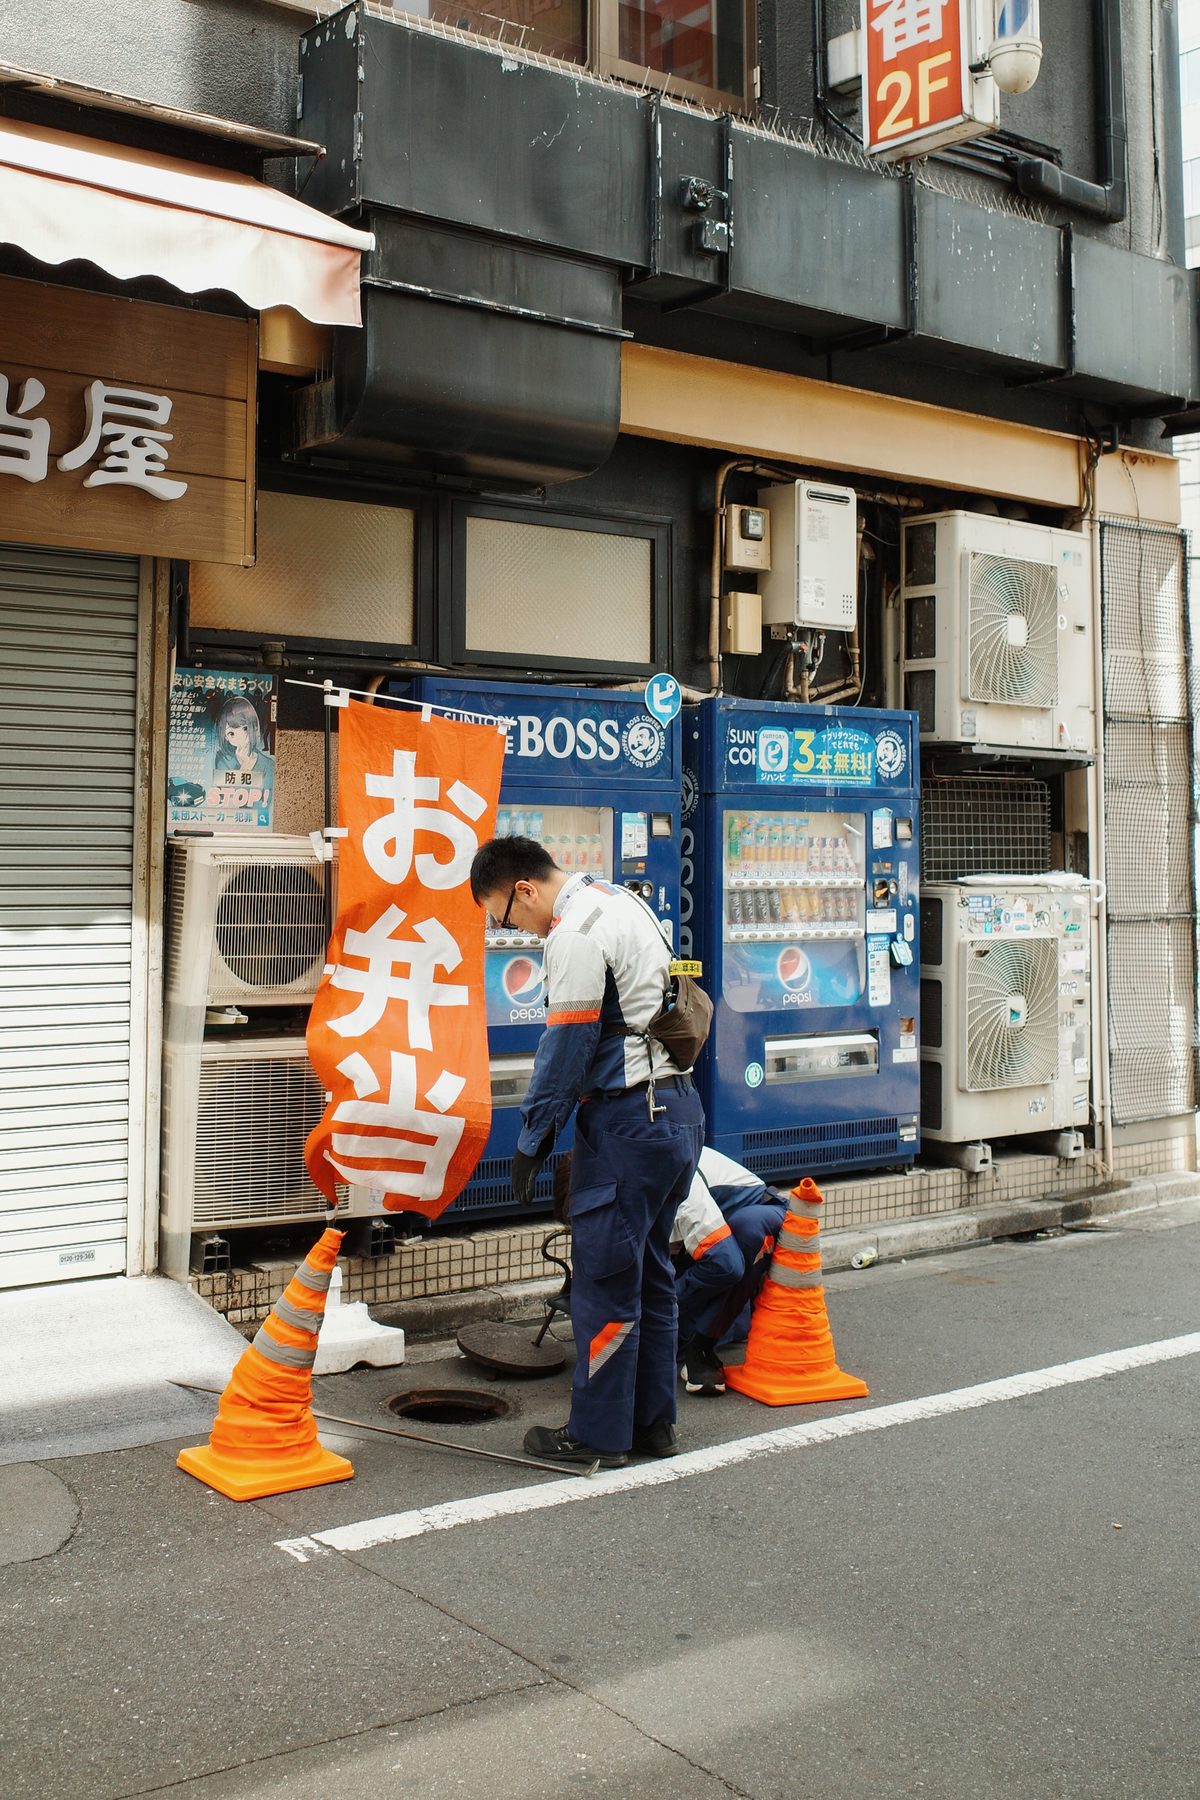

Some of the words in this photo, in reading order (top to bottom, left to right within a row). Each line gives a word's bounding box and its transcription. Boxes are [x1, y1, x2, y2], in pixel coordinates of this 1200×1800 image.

[876, 50, 952, 139] 2F
[173, 673, 273, 693] 安心安全なまちづくり
[653, 680, 676, 713] ピ
[517, 715, 621, 761] BOSS
[821, 729, 869, 745] アプリダウンロード
[225, 772, 252, 785] 防犯
[207, 787, 270, 808] STOP!
[171, 810, 253, 823] 集団ストーカー犯罪
[324, 750, 488, 1201] お弁当
[783, 990, 812, 1006] pepsi
[509, 1005, 546, 1023] pepsi
